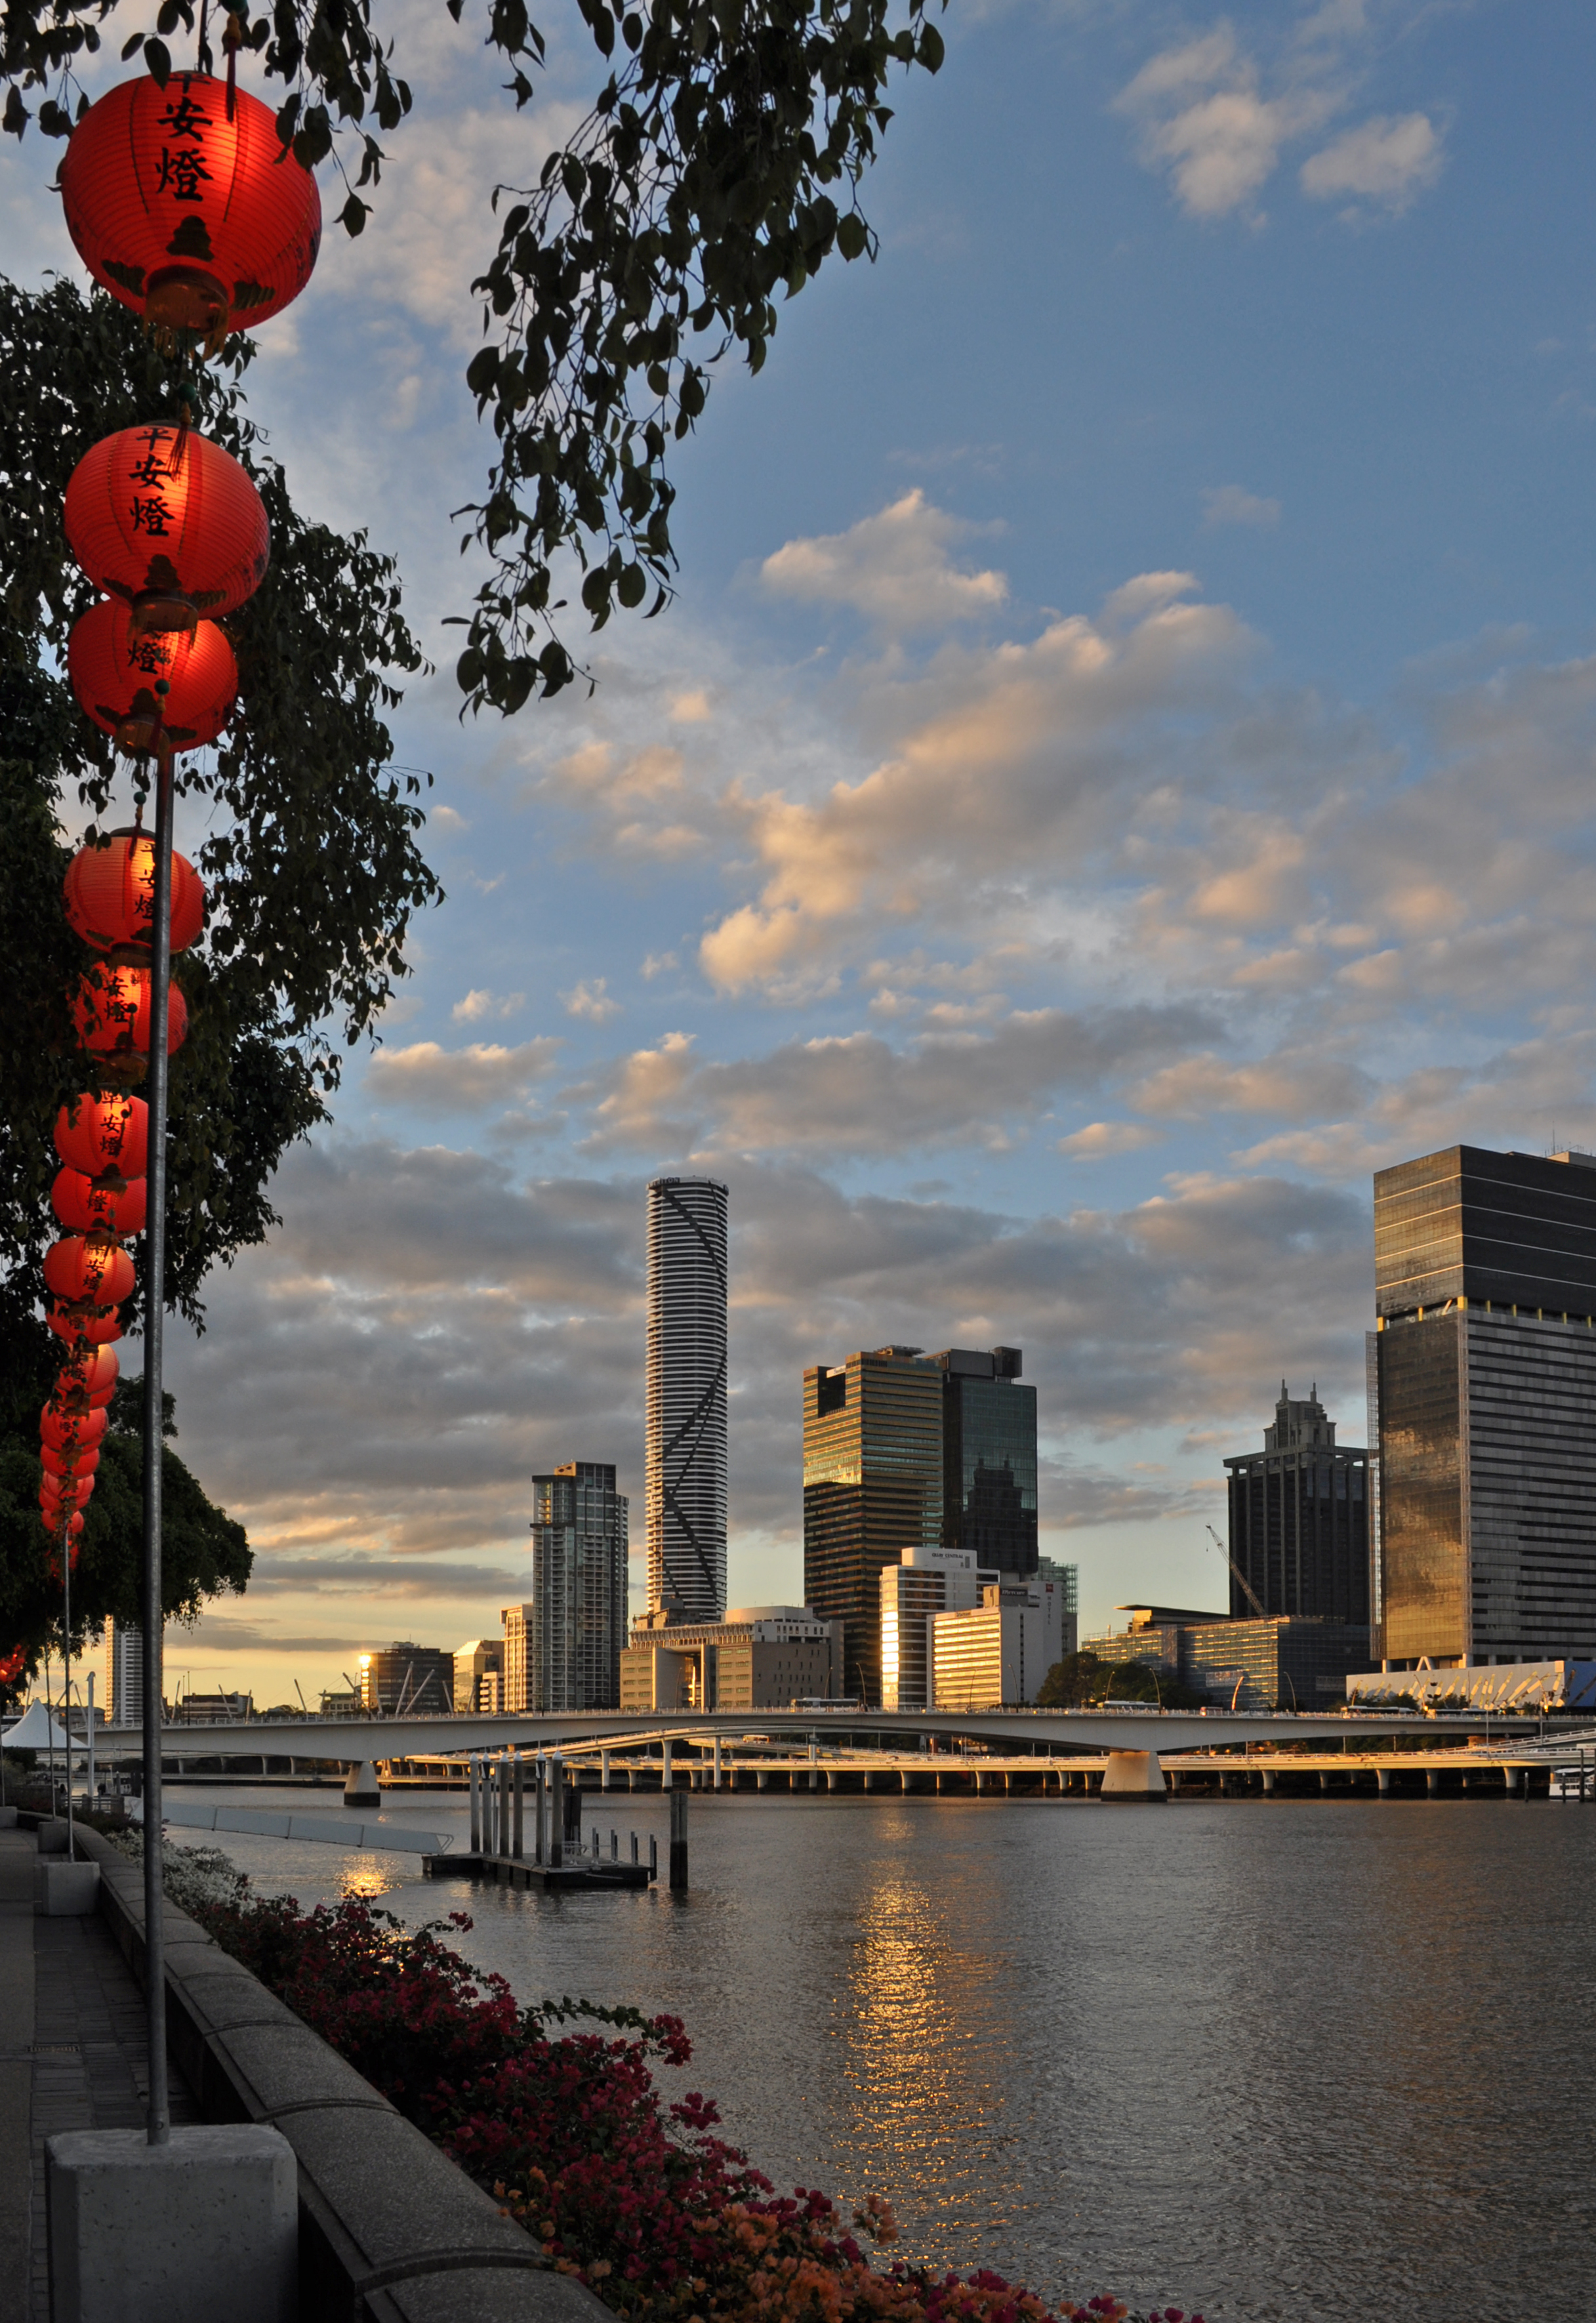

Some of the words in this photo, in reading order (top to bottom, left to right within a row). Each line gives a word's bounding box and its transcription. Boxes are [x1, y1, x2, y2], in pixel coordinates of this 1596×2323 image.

[155, 72, 214, 202] 平安燈
[129, 428, 175, 537] 平安燈
